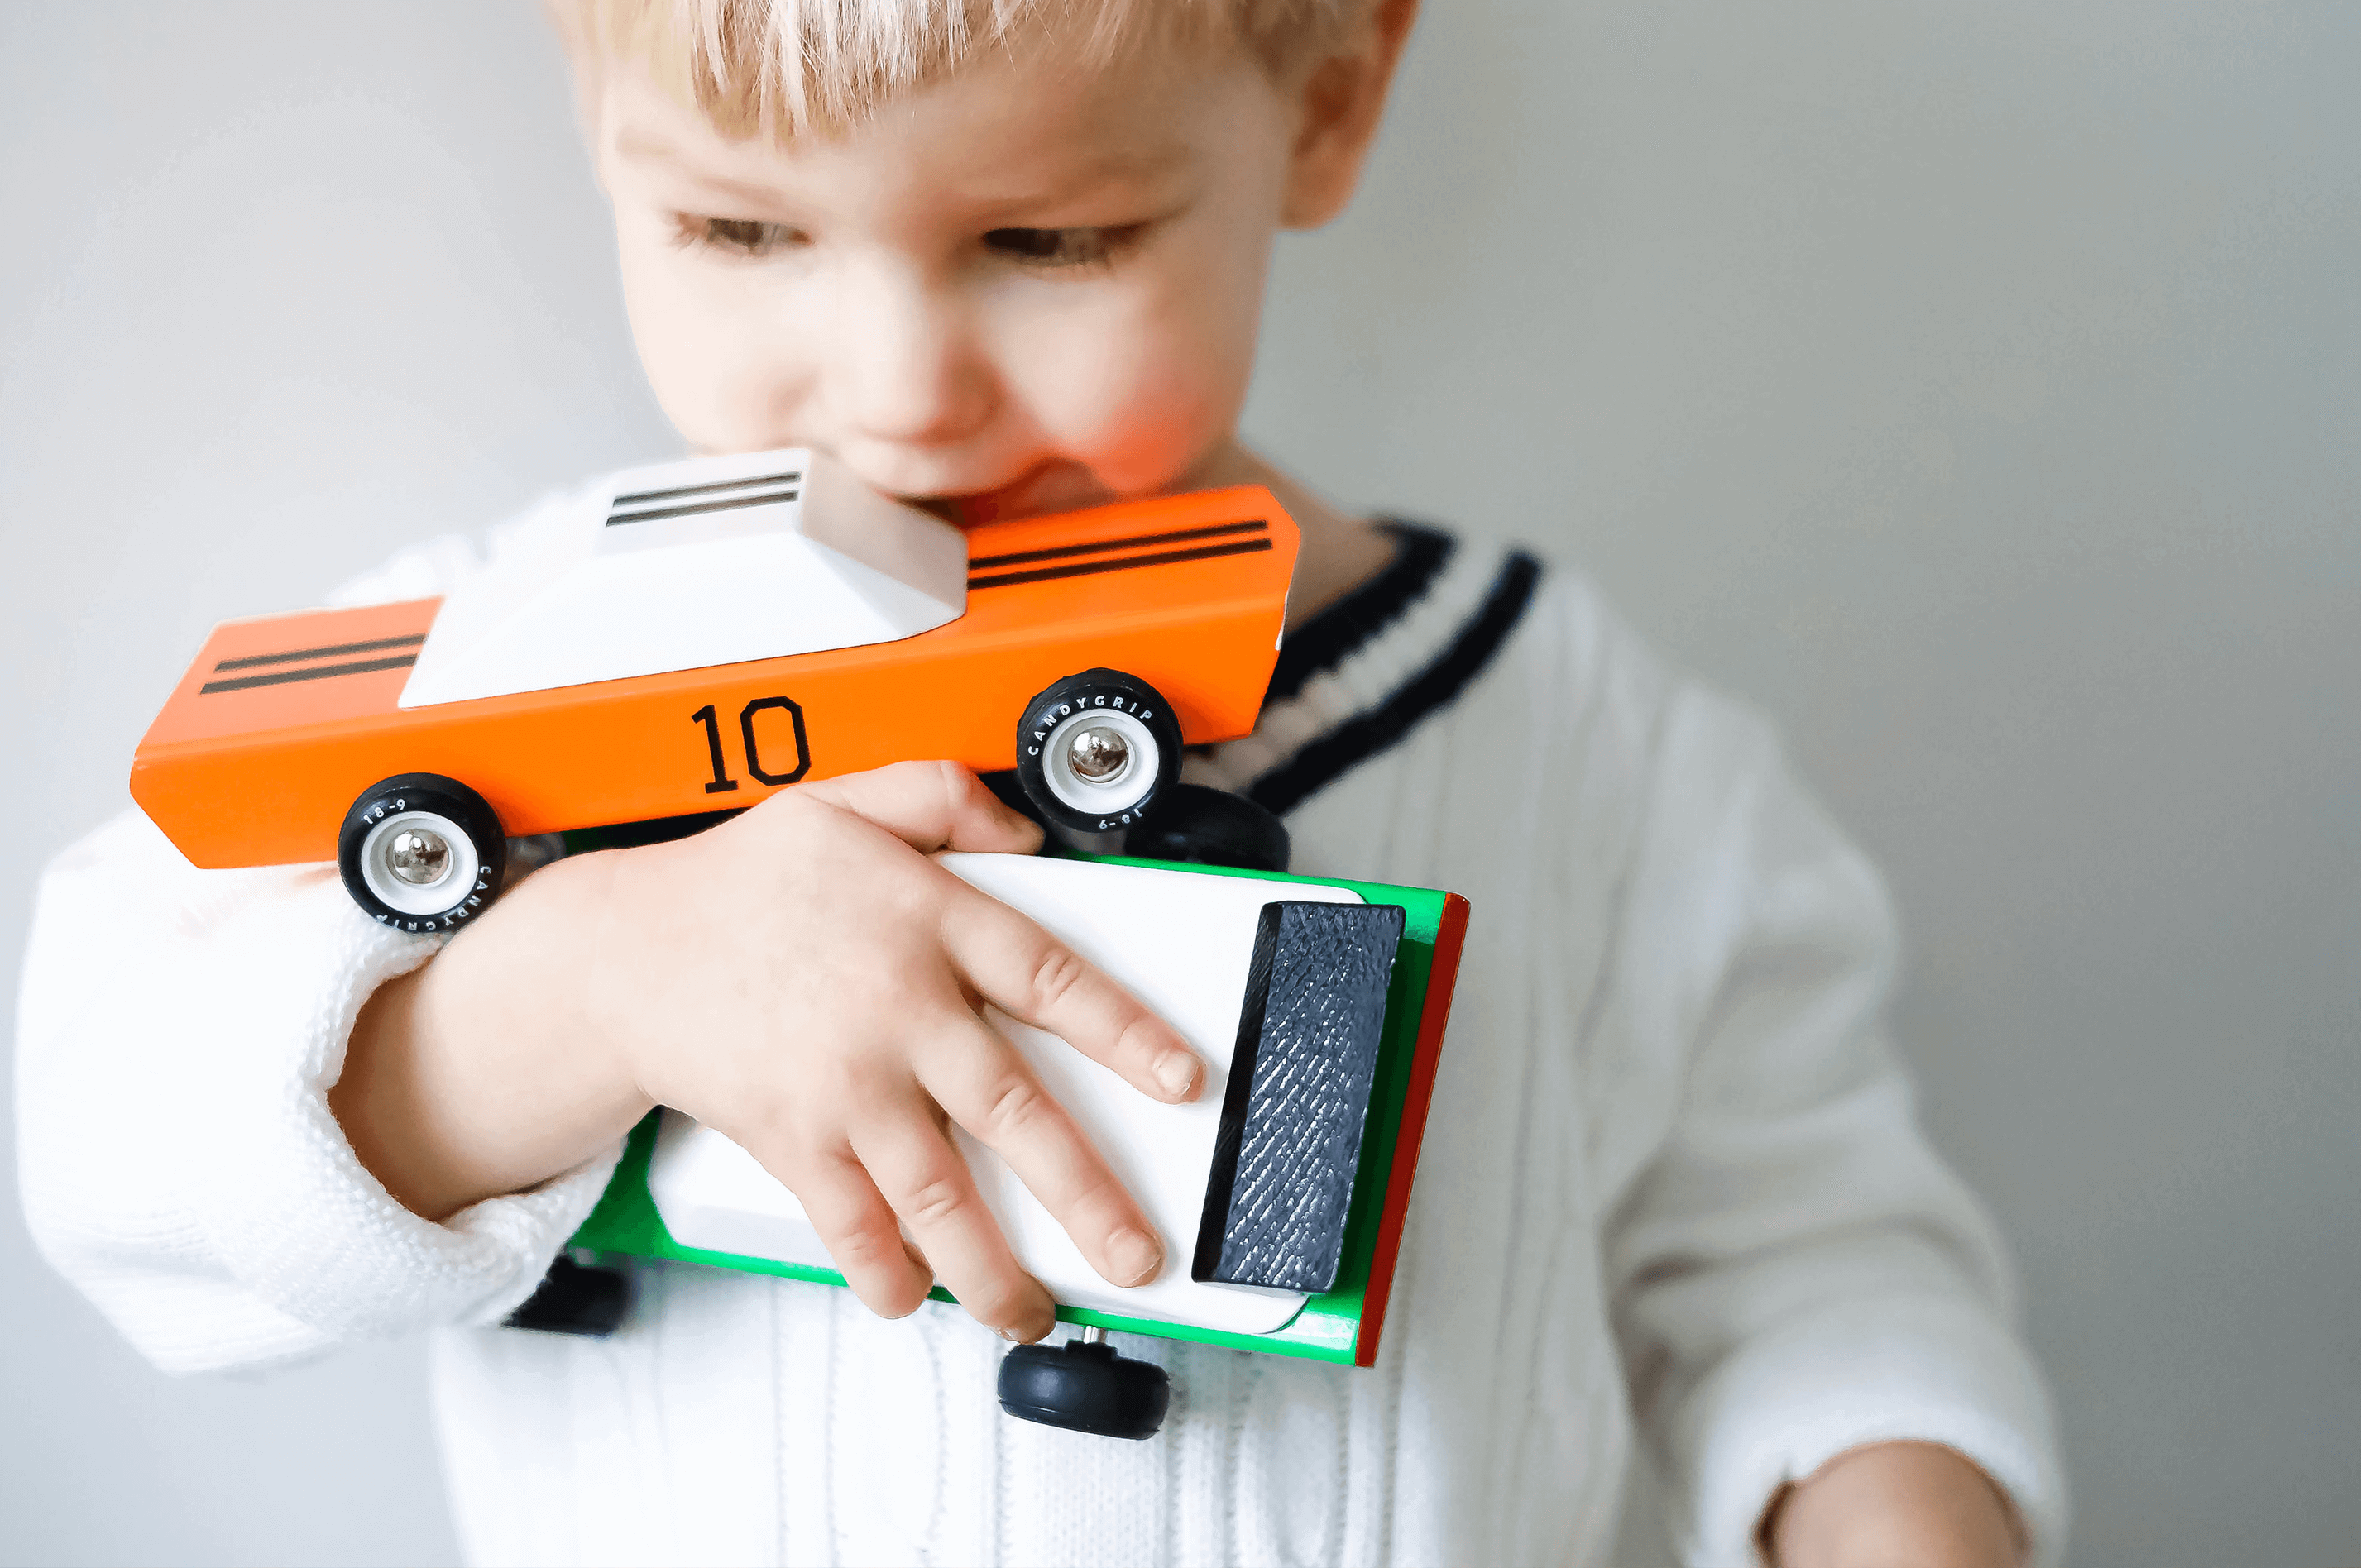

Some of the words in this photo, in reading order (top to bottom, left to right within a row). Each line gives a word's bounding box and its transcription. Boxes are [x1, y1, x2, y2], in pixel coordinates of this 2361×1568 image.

[691, 696, 812, 794] 10
[1027, 695, 1153, 757] CANDYGRIP
[362, 798, 406, 825] 18-9
[375, 864, 492, 932] CANDYGRIP
